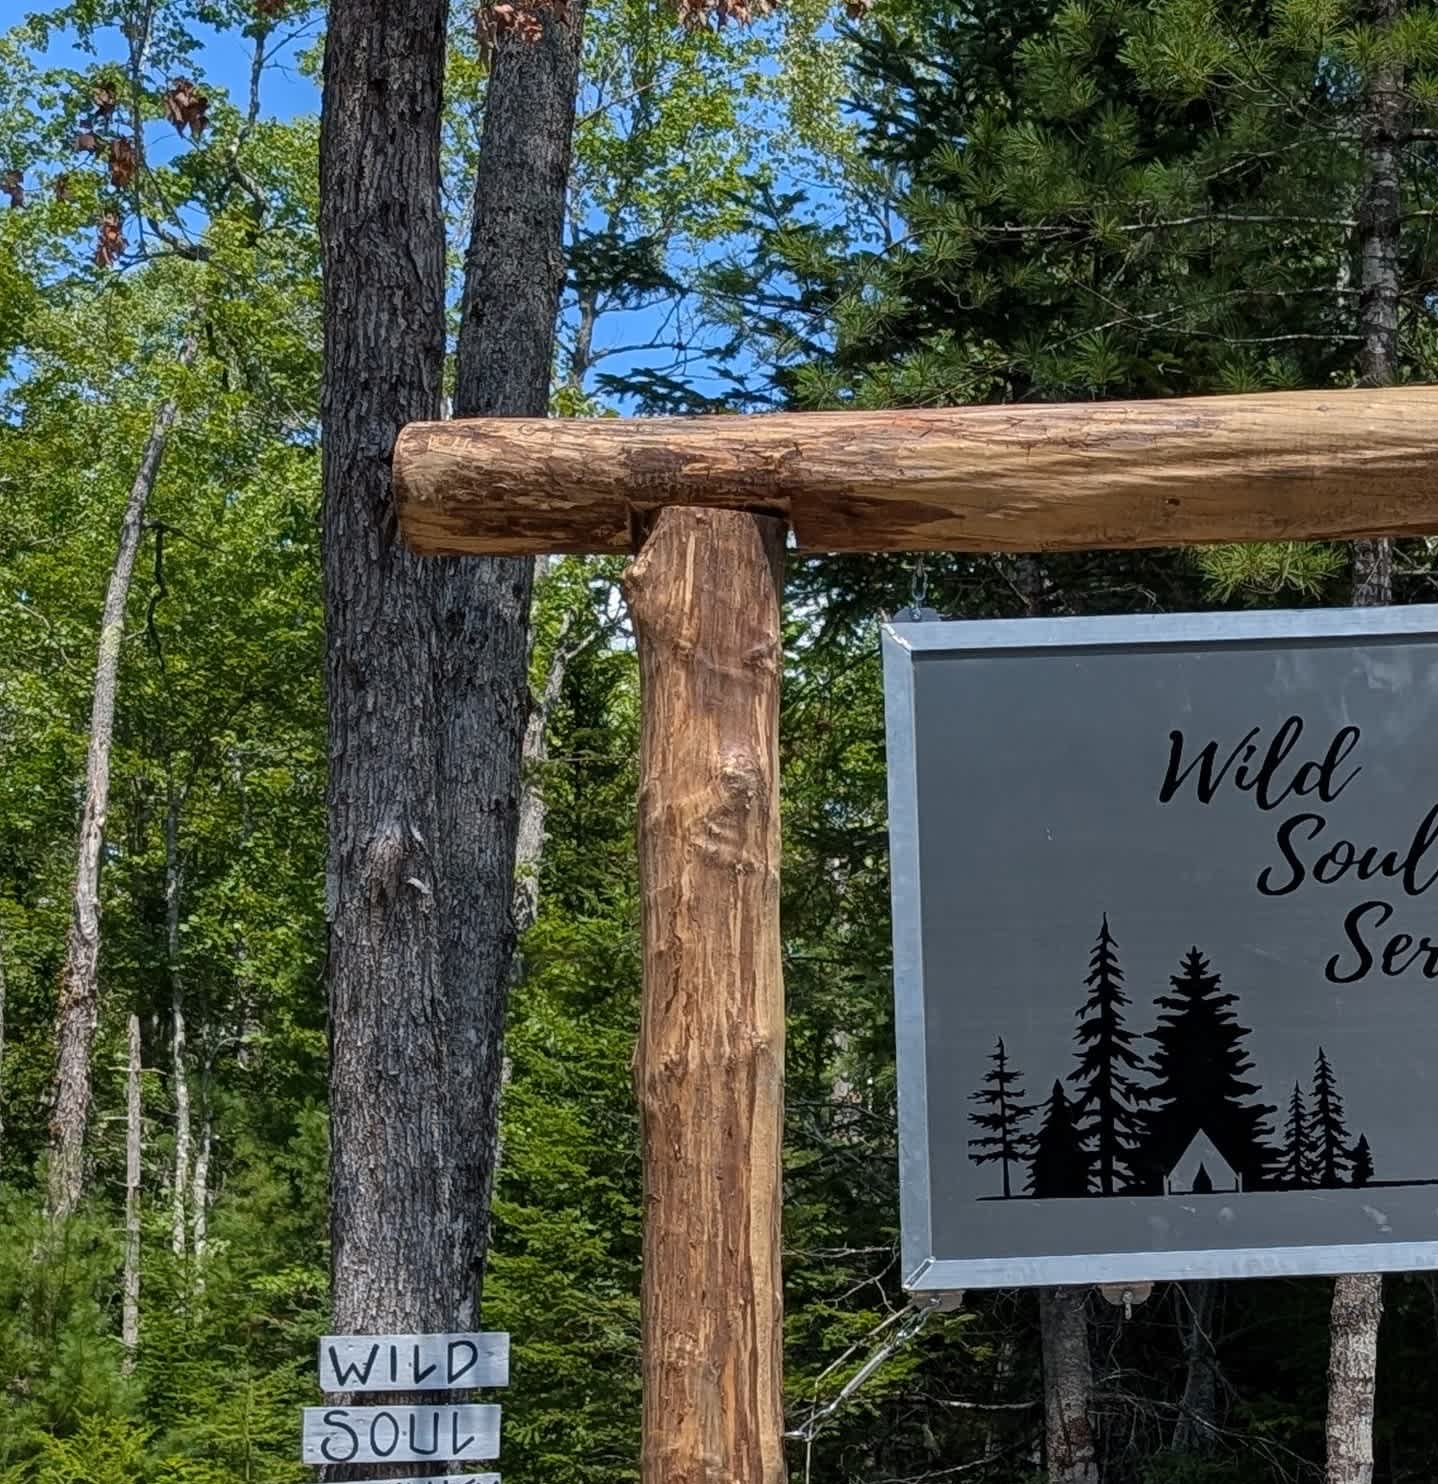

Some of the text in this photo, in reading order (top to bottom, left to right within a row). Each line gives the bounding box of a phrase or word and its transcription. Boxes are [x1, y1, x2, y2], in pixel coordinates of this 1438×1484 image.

[1158, 715, 1362, 811] Wild
[328, 1340, 479, 1387] WILD
[320, 1409, 475, 1462] SOUL
